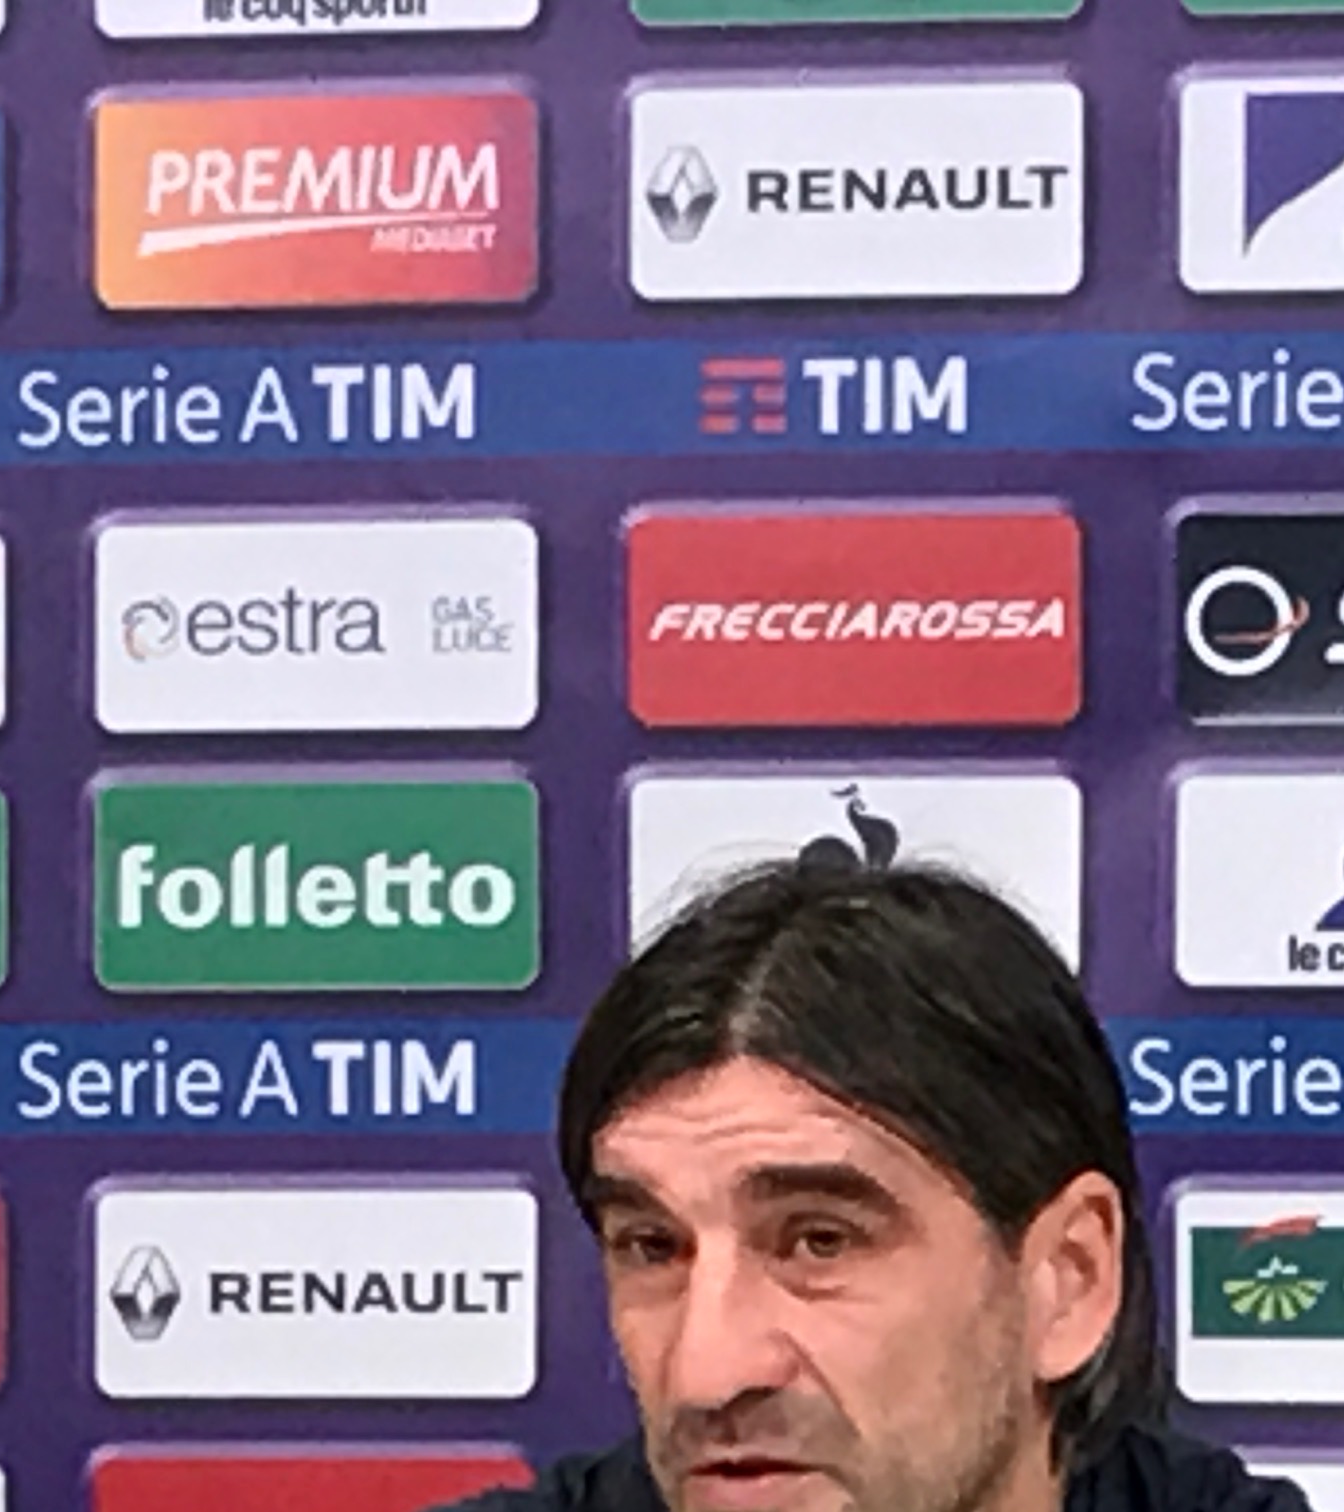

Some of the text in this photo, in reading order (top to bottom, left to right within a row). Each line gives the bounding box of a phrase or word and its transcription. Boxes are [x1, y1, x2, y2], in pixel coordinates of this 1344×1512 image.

[144, 144, 499, 216] PREMIUM
[746, 165, 1070, 213] RENAULT
[18, 362, 476, 448] Serie A TIM
[803, 356, 967, 434] TIM
[186, 587, 493, 656] estra GAS
[432, 624, 512, 653] LUCE
[649, 598, 1065, 643] FRECCIAROSSA
[116, 844, 516, 931] folletto
[1288, 935, 1321, 973] le
[17, 1038, 475, 1119] Serie A TIM
[1128, 1035, 1343, 1117] Serie
[209, 1272, 523, 1313] RENAULT
